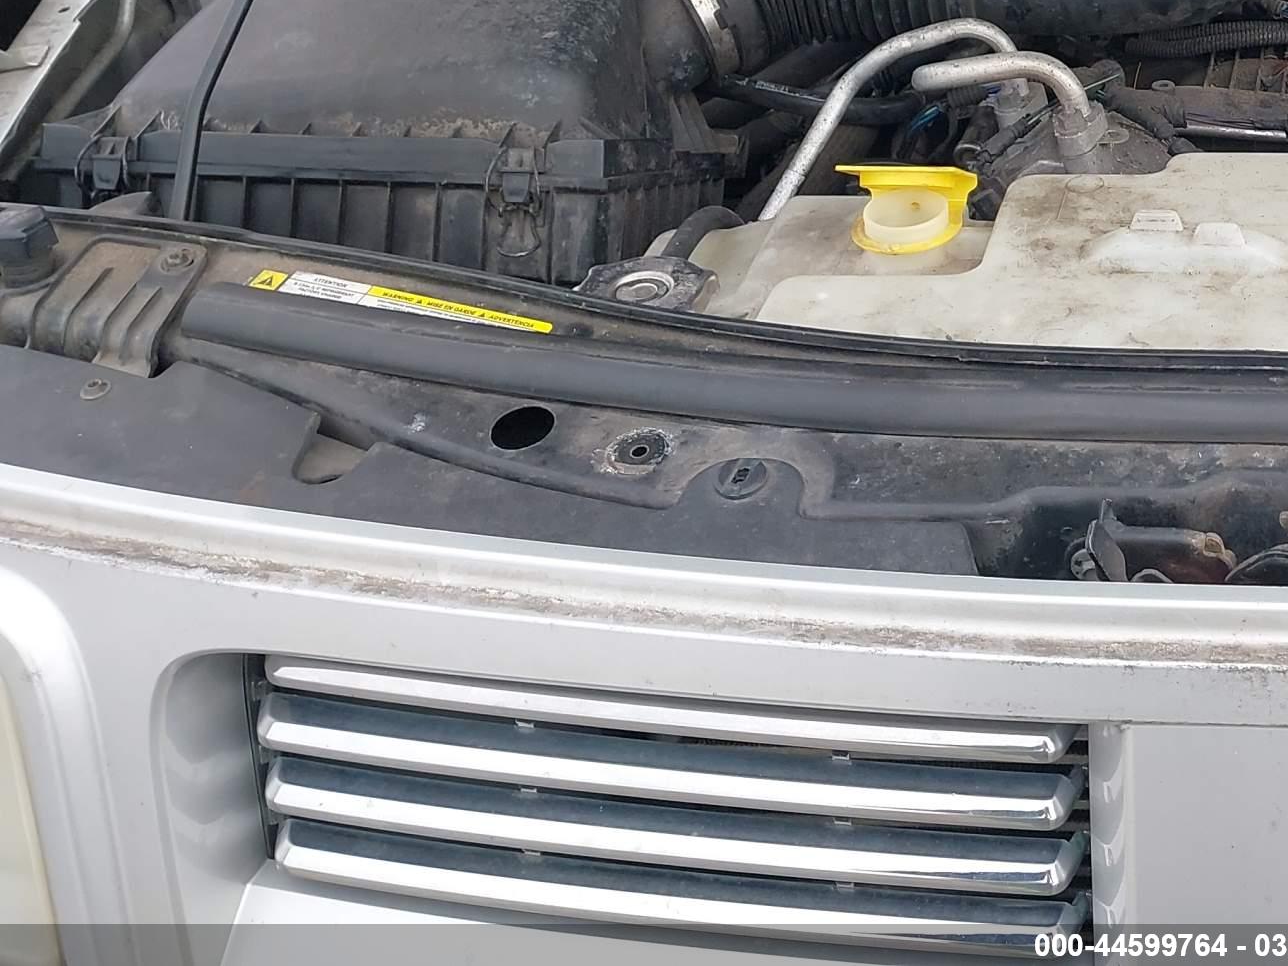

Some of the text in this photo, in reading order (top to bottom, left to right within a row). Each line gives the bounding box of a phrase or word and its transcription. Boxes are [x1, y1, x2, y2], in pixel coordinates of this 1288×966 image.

[382, 291, 414, 303] WARNING
[427, 301, 444, 310] MISE
[454, 307, 477, 317] GARDE
[489, 314, 535, 329] ADVERTENCIA
